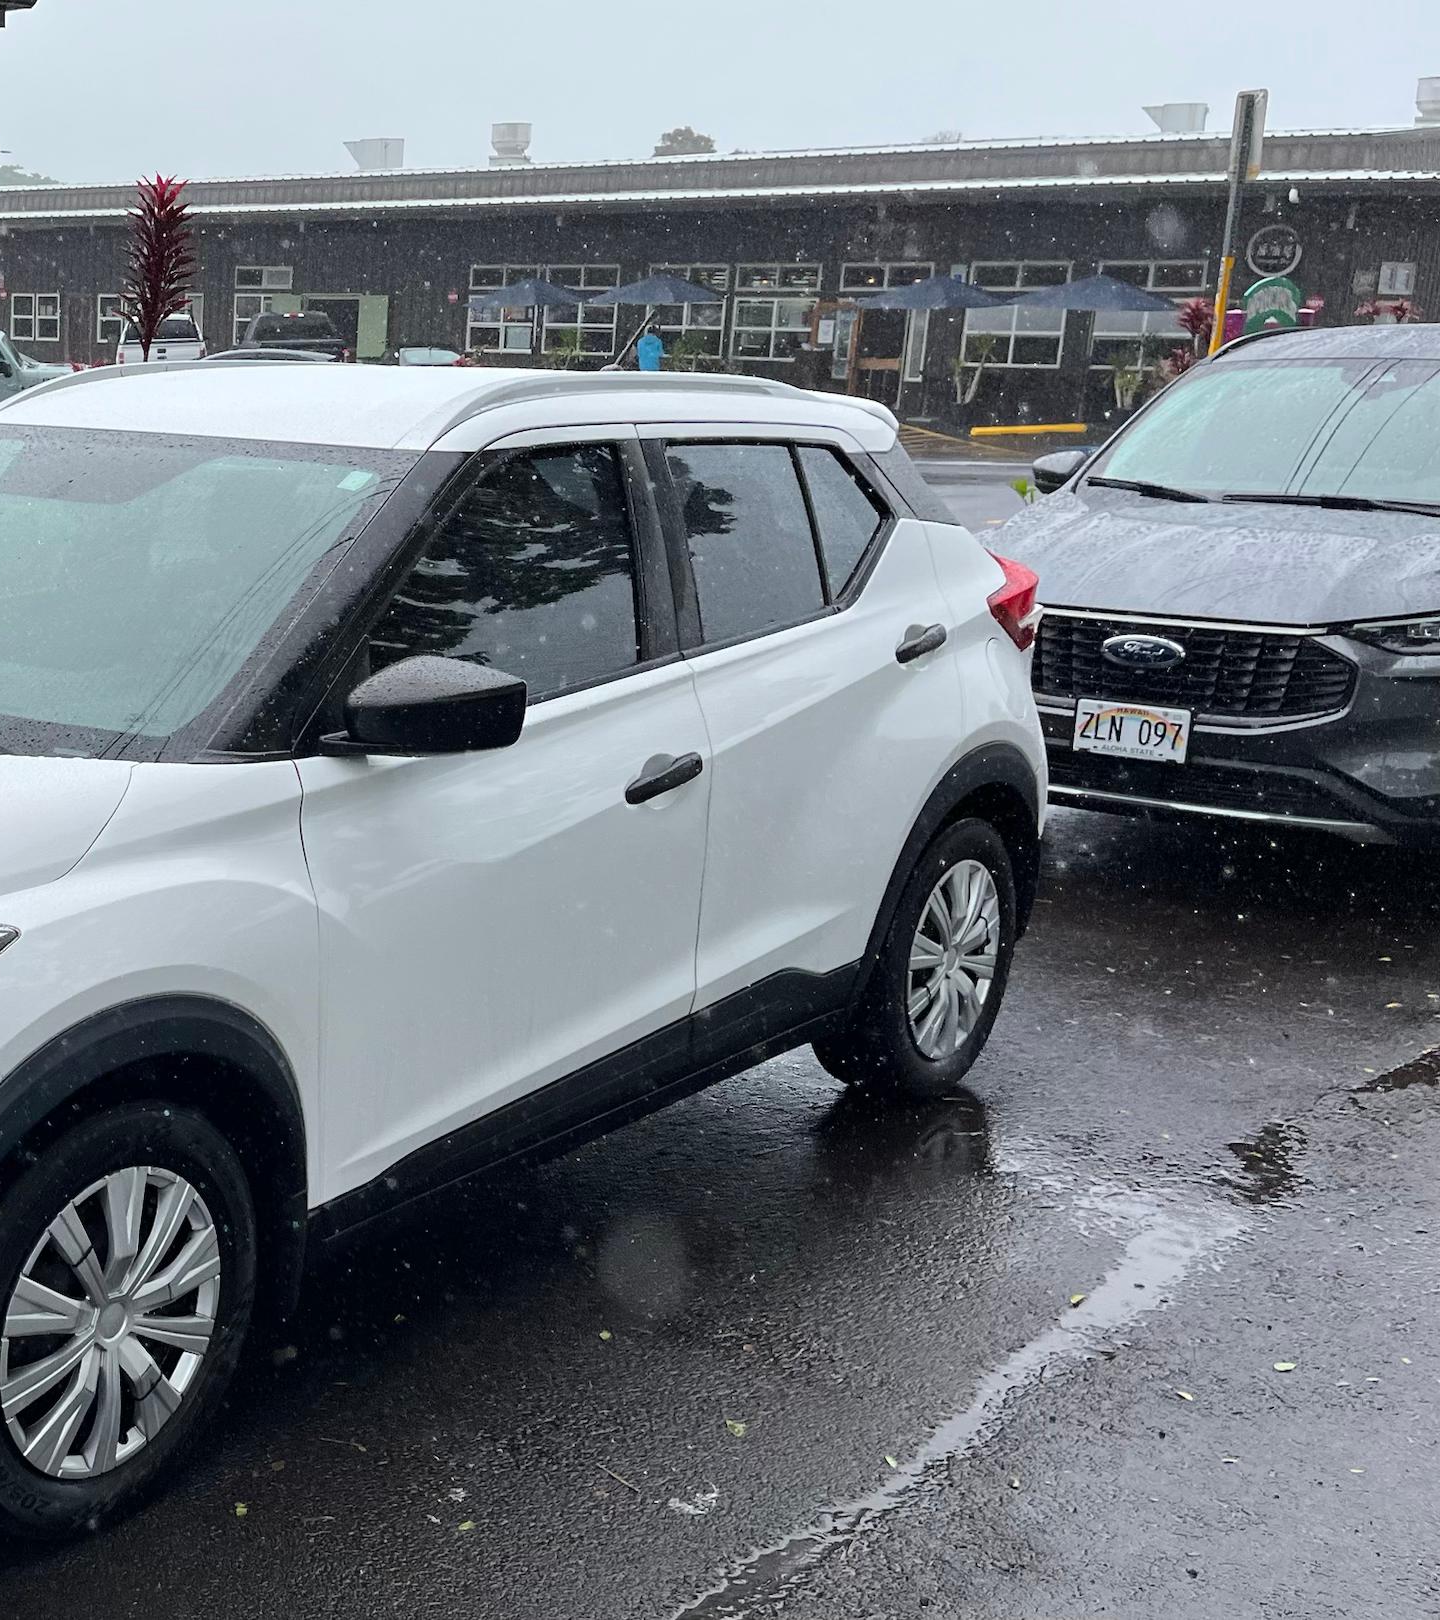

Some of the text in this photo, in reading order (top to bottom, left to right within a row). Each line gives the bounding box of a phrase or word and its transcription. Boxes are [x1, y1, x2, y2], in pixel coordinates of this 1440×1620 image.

[1079, 711, 1183, 750] ZLN 097
[1101, 744, 1155, 757] ALOHA STATE
